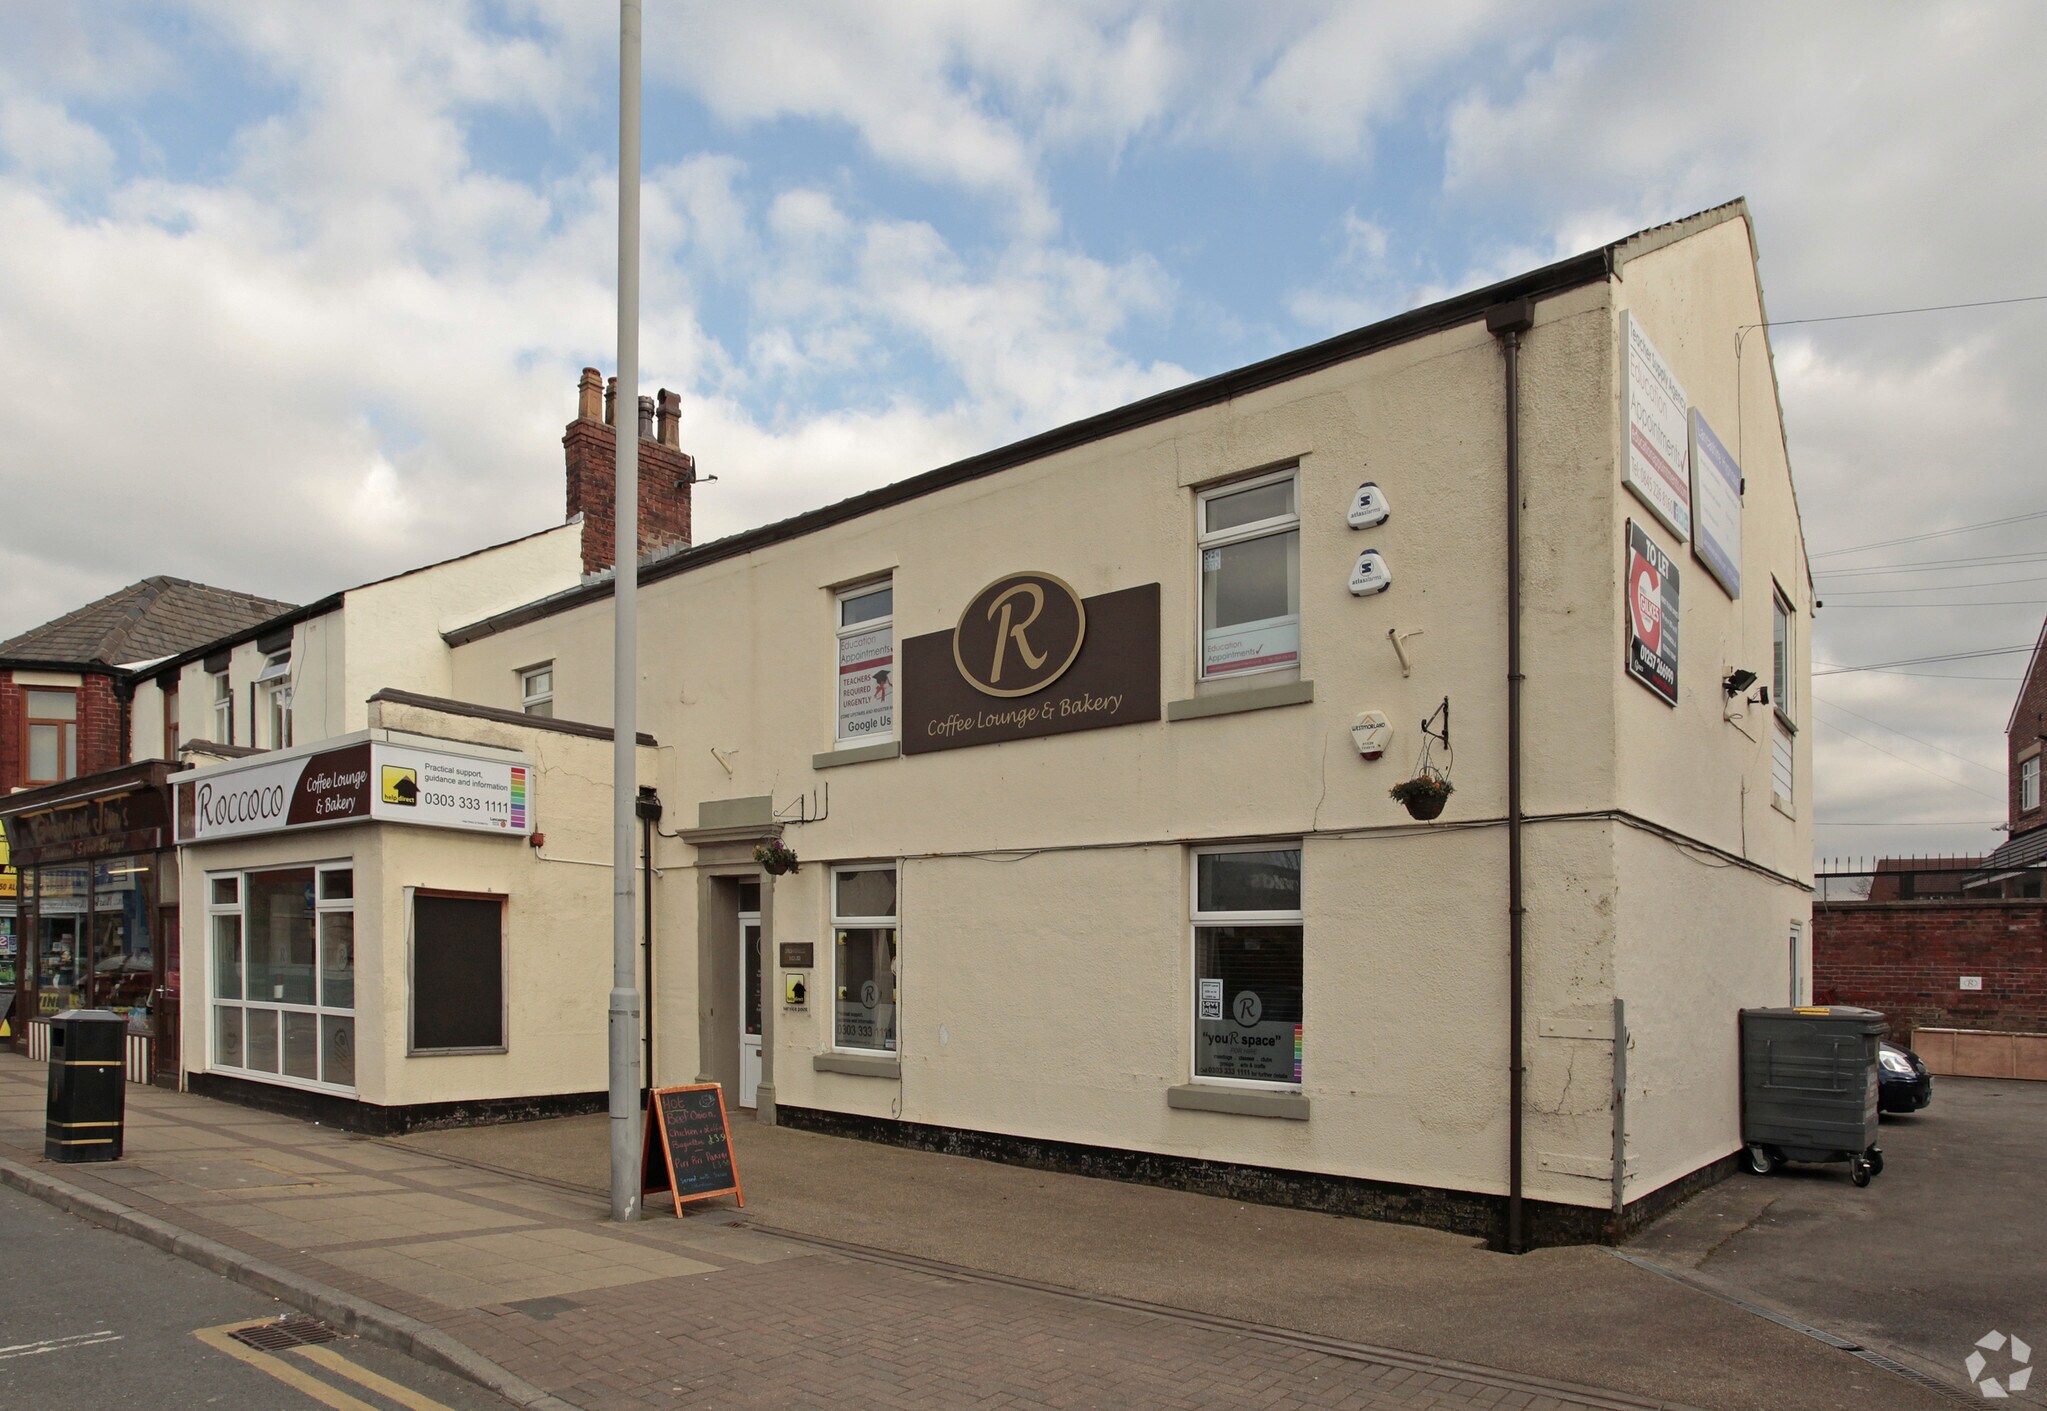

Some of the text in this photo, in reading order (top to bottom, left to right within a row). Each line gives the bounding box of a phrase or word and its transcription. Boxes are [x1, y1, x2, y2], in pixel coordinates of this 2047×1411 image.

[1630, 321, 1686, 414] Teacher Supply Agency
[1630, 354, 1667, 420] Education
[1631, 391, 1680, 468] Appointments
[1645, 538, 1657, 567] TO
[1657, 554, 1670, 581] LET
[841, 636, 877, 650] Education
[1207, 641, 1242, 652] Education
[841, 645, 890, 663] Appointments
[1207, 648, 1255, 662] Appointments
[1640, 643, 1656, 671] 01257
[843, 674, 872, 687] TEACHERS
[843, 685, 871, 697] REQUIRED
[843, 696, 872, 708] URGENTLY
[927, 693, 1123, 736] Coffee Lounge & Bakery
[848, 715, 892, 732] Google Us
[424, 763, 483, 779] Practical support,
[306, 770, 368, 794] Coffee Lounge
[424, 774, 508, 791] guidance and information
[316, 794, 356, 815] & Bakery
[424, 792, 508, 814] 0303 333 1111
[858, 1026, 873, 1037] 333
